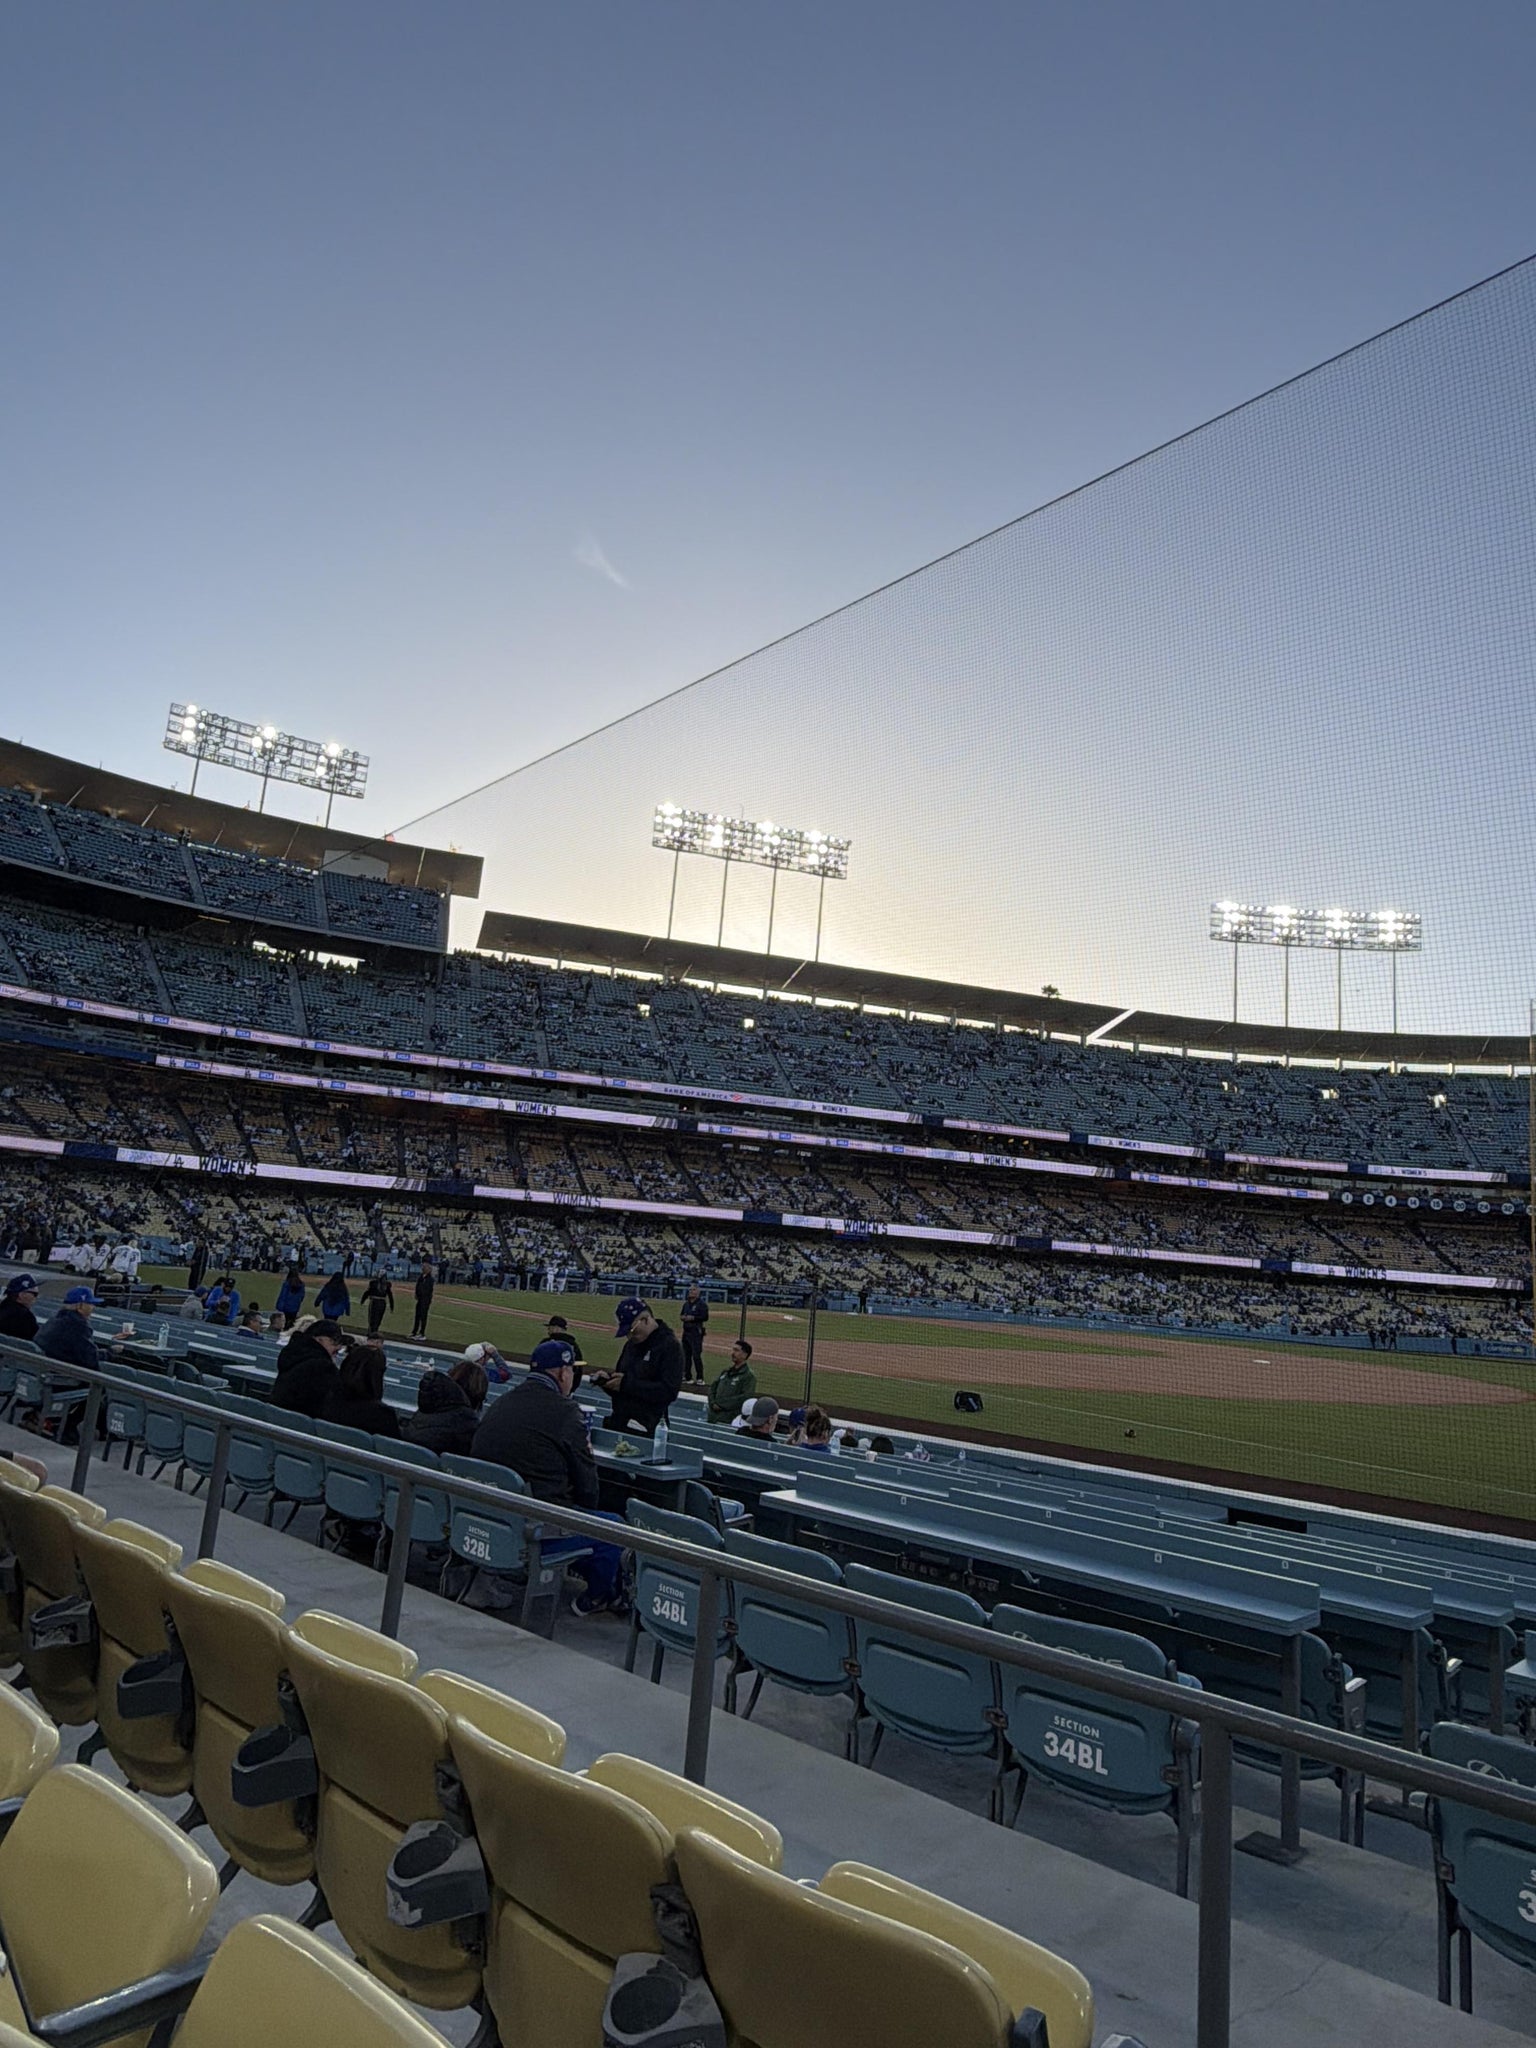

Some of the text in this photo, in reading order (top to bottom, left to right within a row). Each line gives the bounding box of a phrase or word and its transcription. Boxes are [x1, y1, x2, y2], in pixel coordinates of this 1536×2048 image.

[515, 1101, 557, 1116] WOMEN'S
[200, 1156, 258, 1176] WOMEN'S
[983, 1154, 1017, 1168] WOMEN'S
[553, 1191, 601, 1207] WOMEN'S
[843, 1218, 888, 1235] WOMEN'S
[1345, 1265, 1387, 1281] WOMEN'S
[468, 1525, 490, 1539] SECTION
[462, 1535, 492, 1561] 32BL
[658, 1583, 685, 1599] SECTION
[651, 1596, 688, 1626] 34BL
[1053, 1715, 1100, 1738] SECTION
[1043, 1731, 1109, 1776] 34BL
